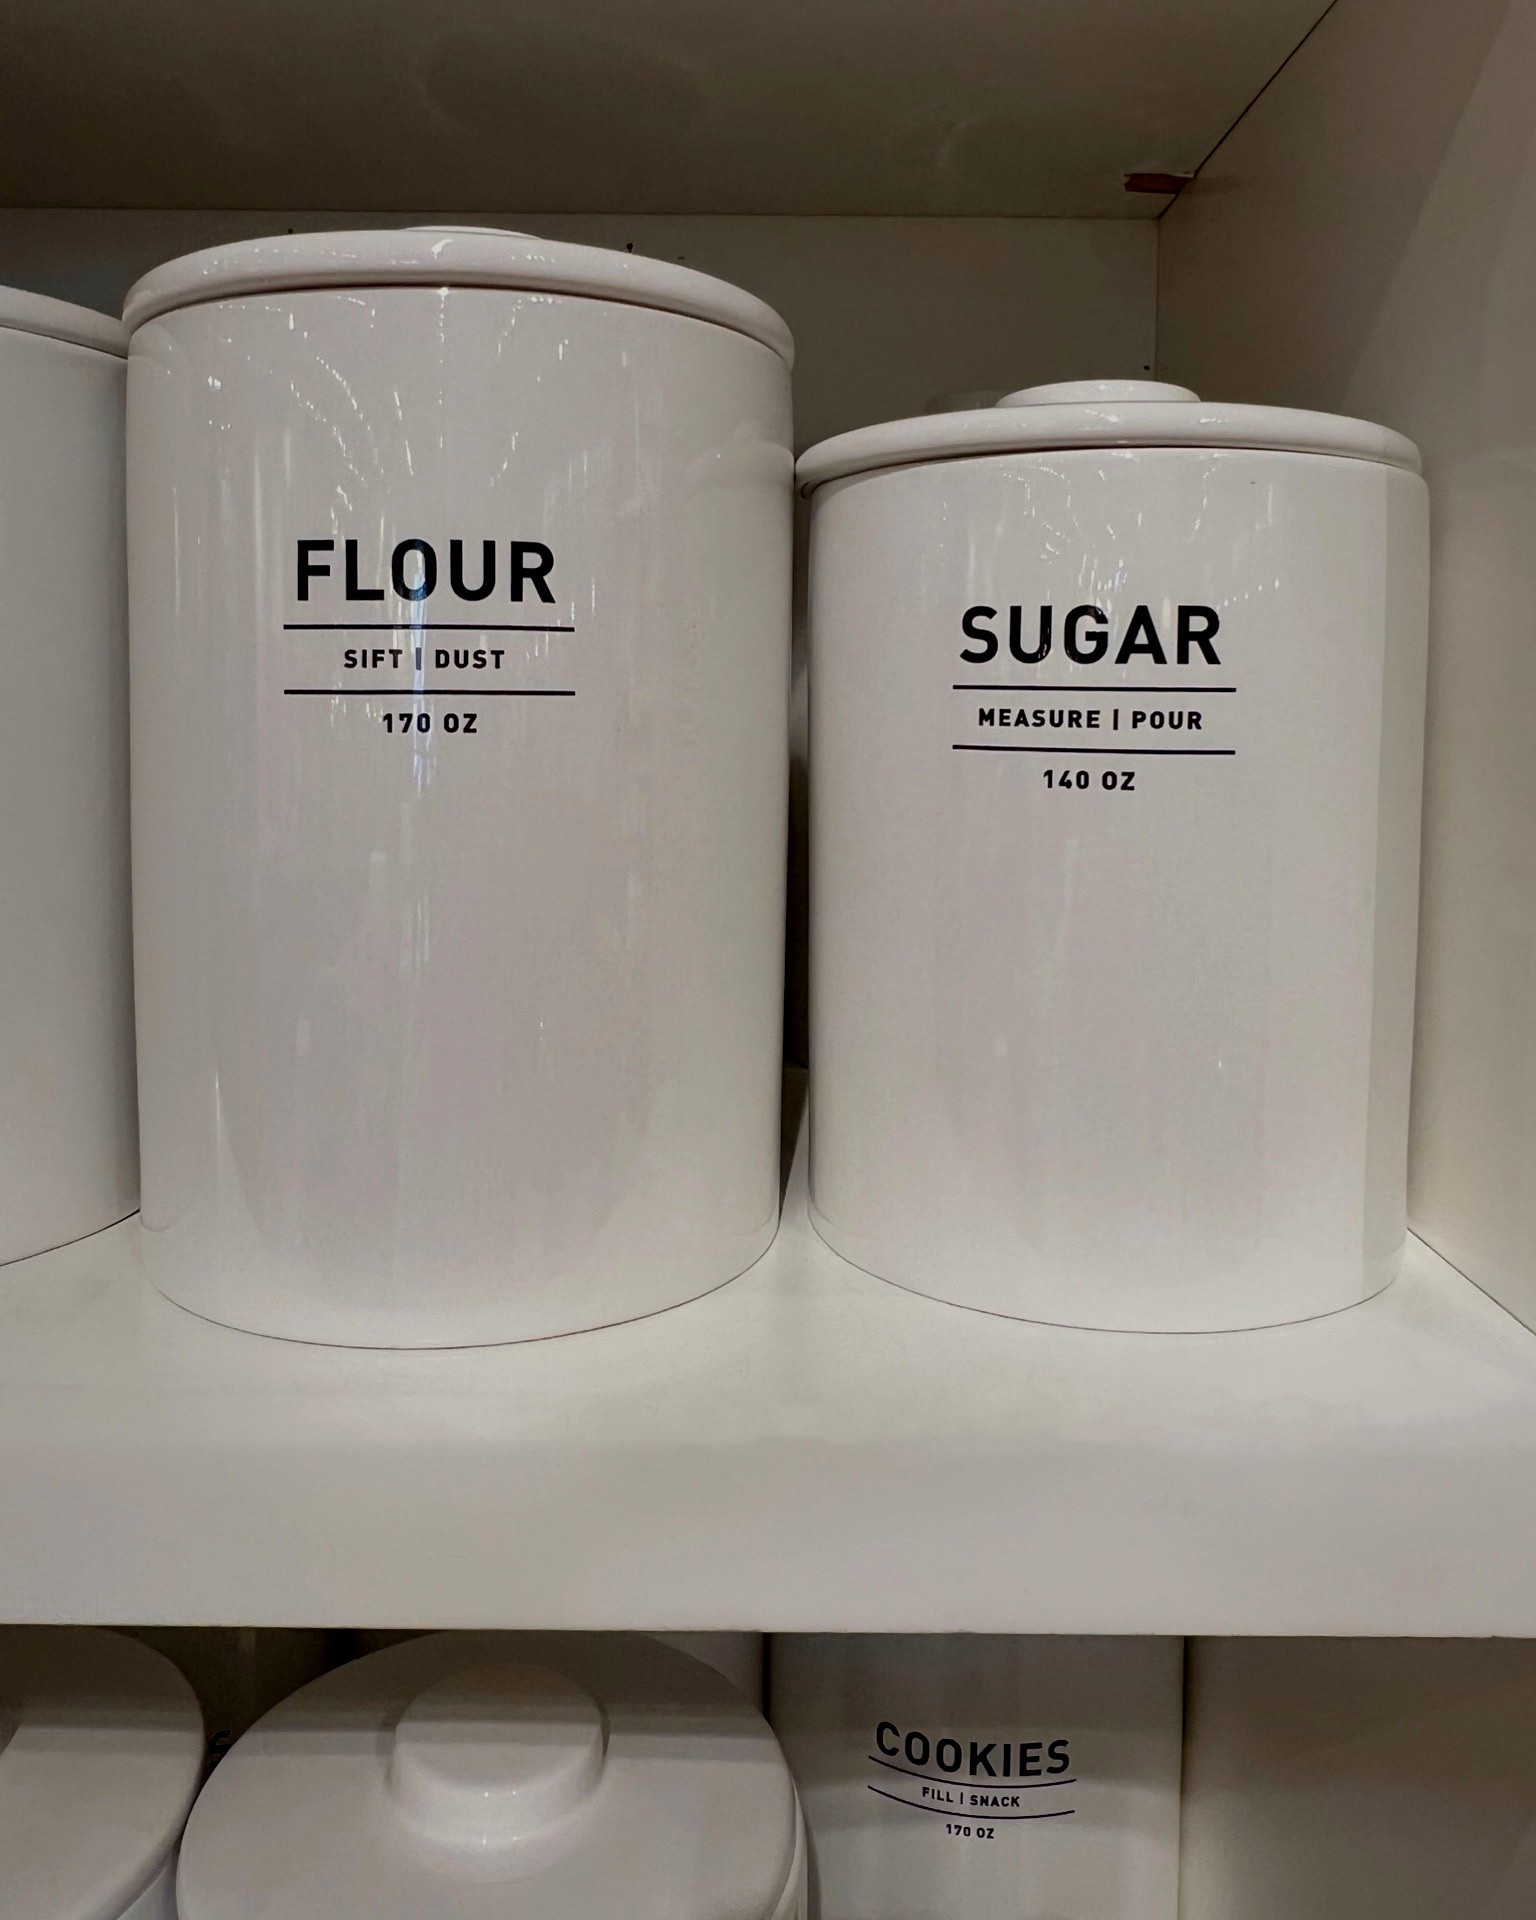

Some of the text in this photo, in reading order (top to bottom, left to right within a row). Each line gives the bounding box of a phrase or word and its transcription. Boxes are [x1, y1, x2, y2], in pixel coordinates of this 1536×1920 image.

[297, 539, 556, 603] FLOUR
[960, 605, 1221, 664] SUGAR
[344, 649, 403, 668] SIFT
[435, 650, 505, 668] DUST
[383, 713, 477, 733] 170 OZ
[978, 708, 1100, 728] MEASURE
[1132, 711, 1202, 729] POUR
[1044, 770, 1135, 790] 140 OZ
[877, 1721, 1070, 1777] COOKIES
[922, 1787, 953, 1802] FILL
[970, 1795, 1020, 1807] SNACK
[946, 1824, 994, 1839] 170 OZ
